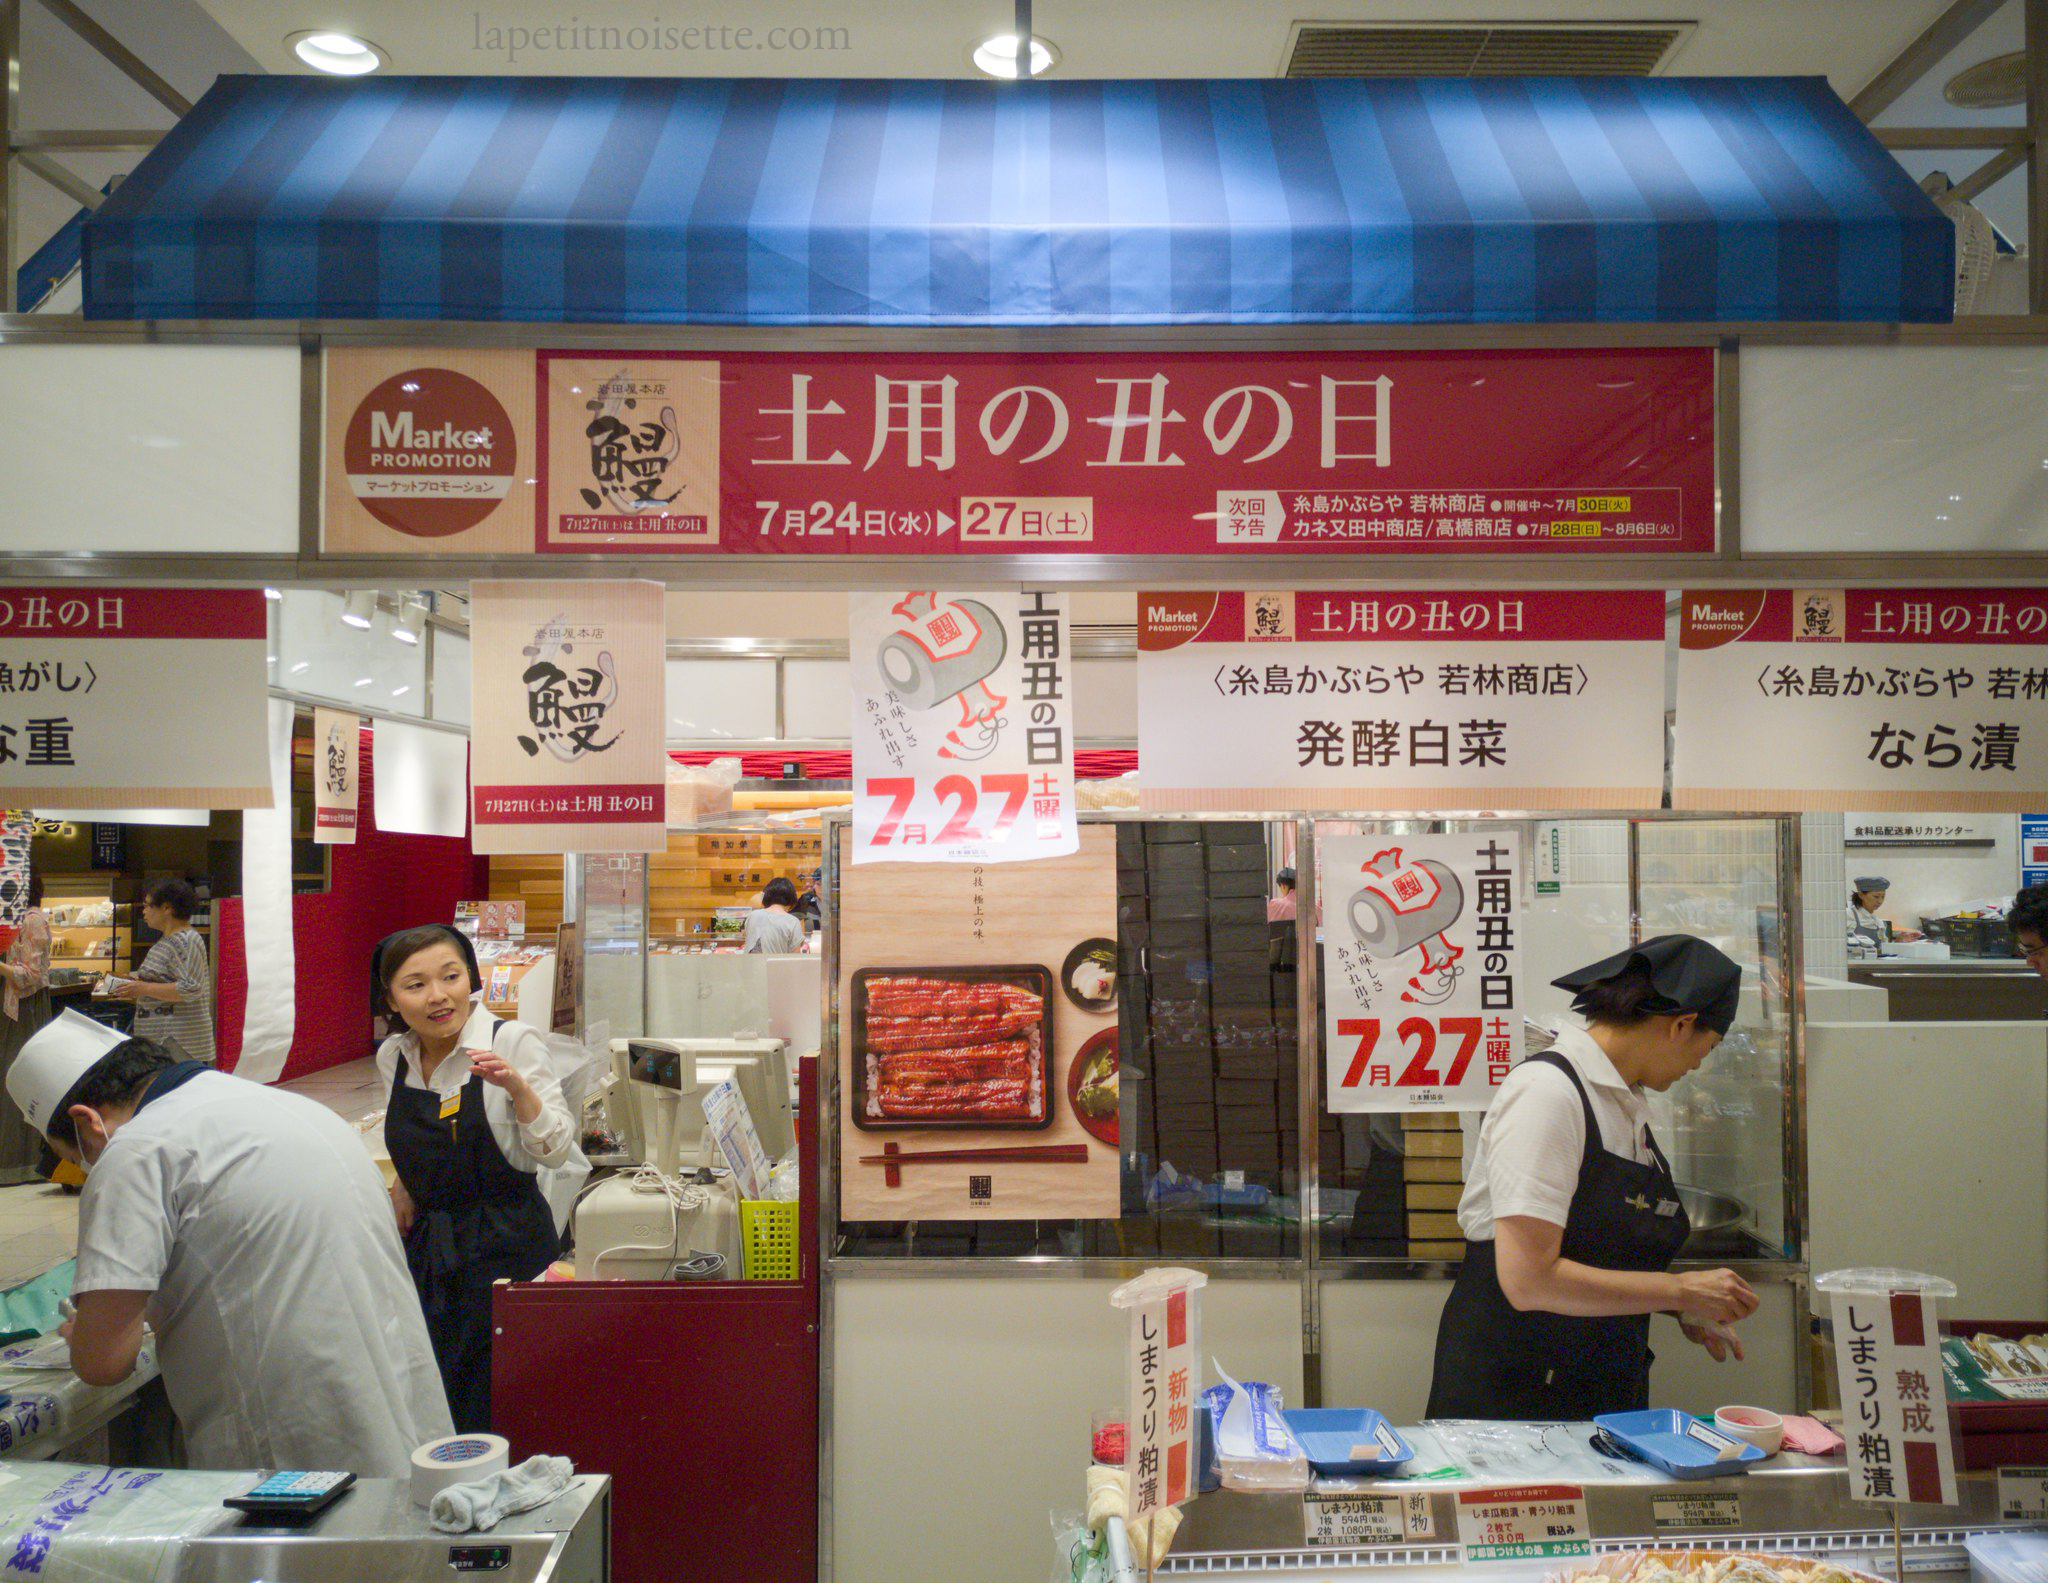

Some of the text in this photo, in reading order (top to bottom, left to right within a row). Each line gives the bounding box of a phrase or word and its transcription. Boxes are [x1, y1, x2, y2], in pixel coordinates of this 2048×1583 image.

[371, 411, 493, 449] Market
[751, 372, 1395, 472] 土用の丑の日
[371, 453, 491, 468] PROMOTION
[367, 480, 495, 493] マーケットプロモーション
[755, 500, 1088, 537] 7月24日(水) 27日(土)
[1228, 498, 1266, 516] 次回
[1293, 495, 1403, 514] 糸島かぶらや
[1410, 494, 1486, 513] 若林商店
[1229, 518, 1266, 537] 予告
[1148, 606, 1198, 623] Market
[1310, 600, 1525, 633] 土用の丑の日
[1692, 604, 1744, 621] Market
[1692, 623, 1743, 631] PROMOTION
[866, 698, 905, 769] あふれ出す
[885, 690, 917, 748] 美味しさ
[1297, 719, 1507, 767] 発酵白菜
[1867, 722, 2020, 771] なら漬
[1854, 826, 1974, 836] 食料品配送承りカウンター
[1474, 840, 1514, 1010] 土用丑の日
[1337, 947, 1372, 1011] あふれ出す
[1354, 940, 1383, 993] 美味しさ
[1138, 1314, 1158, 1513] しまうり粕漬
[1168, 1367, 1188, 1435] 新物
[1848, 1306, 1896, 1498] しまうり粕漬
[1896, 1369, 1934, 1433] 熟成
[1320, 1517, 1333, 1526] 1枚
[1321, 1502, 1384, 1514] しまうり粕漬
[1409, 1492, 1428, 1532] 新物
[1317, 1527, 1333, 1536] 2枚
[1479, 1533, 1525, 1544] 1080円
[1487, 1523, 1513, 1533] 2枚で
[1547, 1525, 1575, 1536] 税込み
